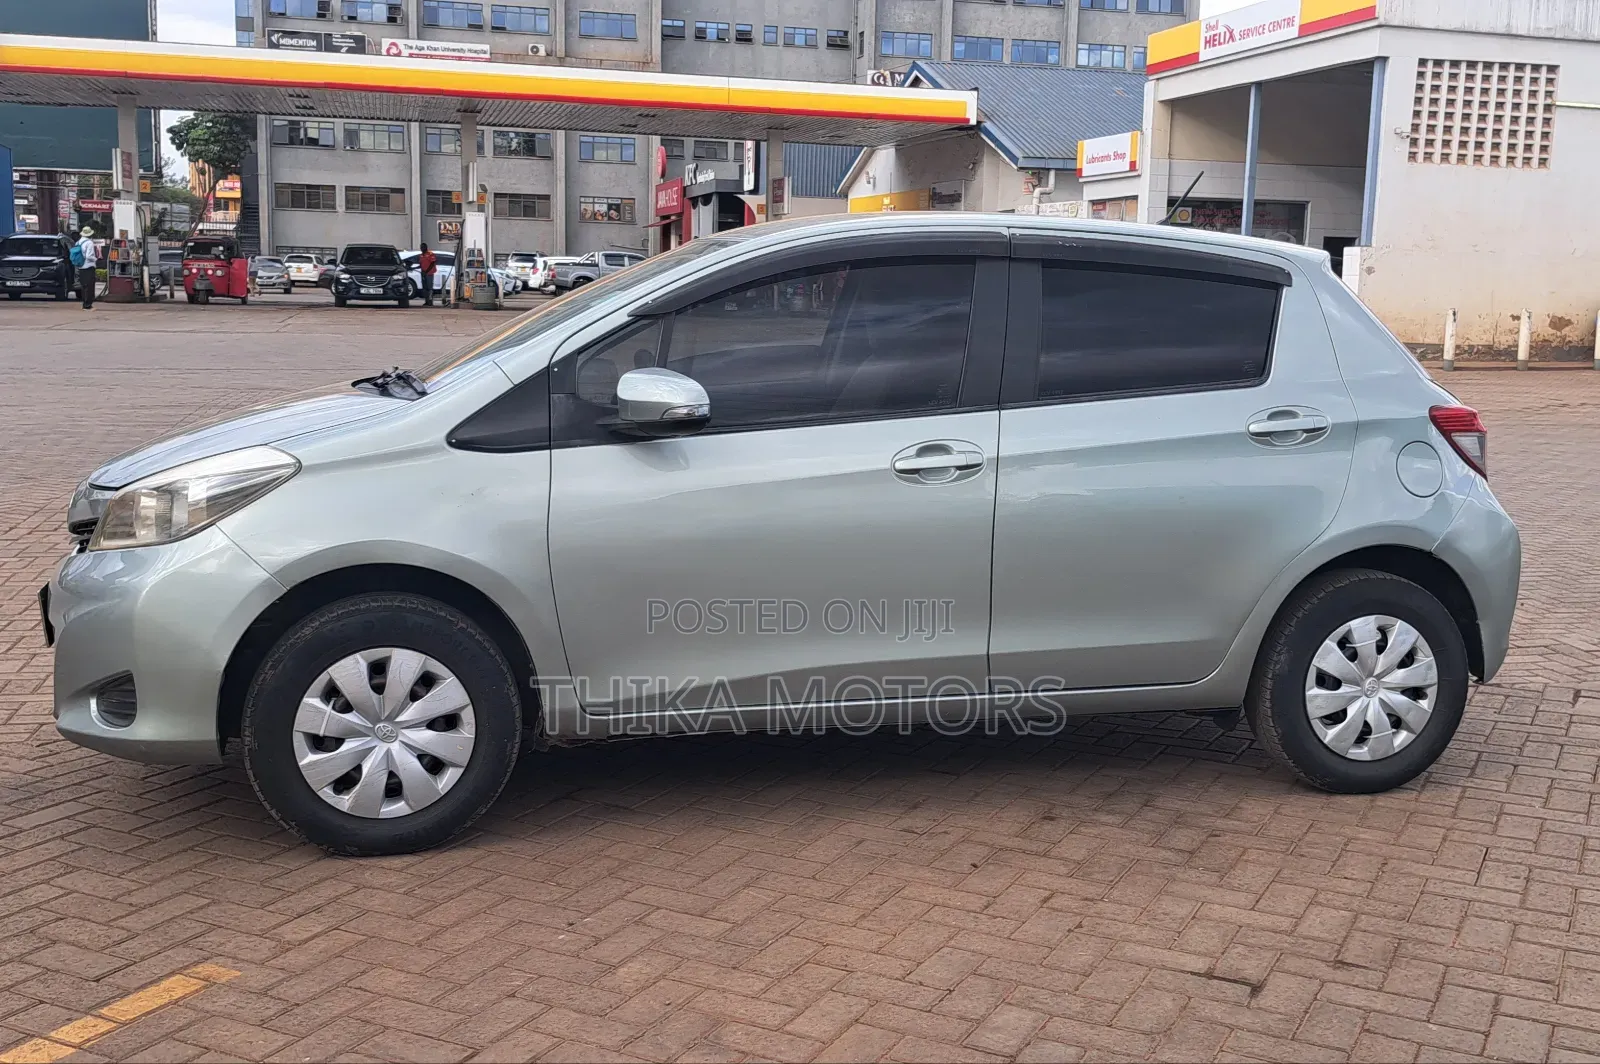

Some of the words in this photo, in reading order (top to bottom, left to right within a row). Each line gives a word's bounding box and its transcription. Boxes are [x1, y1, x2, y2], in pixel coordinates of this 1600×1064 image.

[1203, 27, 1236, 50] HELIX
[1238, 24, 1266, 41] SERVICE
[1268, 15, 1296, 33] CENTRE
[1205, 19, 1219, 33] Shell
[279, 38, 317, 47] MOMENTUM
[441, 46, 466, 54] University
[467, 47, 489, 55] Hospital
[1086, 153, 1112, 165] Lubricants
[1112, 150, 1127, 162] Shop
[685, 162, 698, 187] KFC
[142, 182, 148, 190] 2
